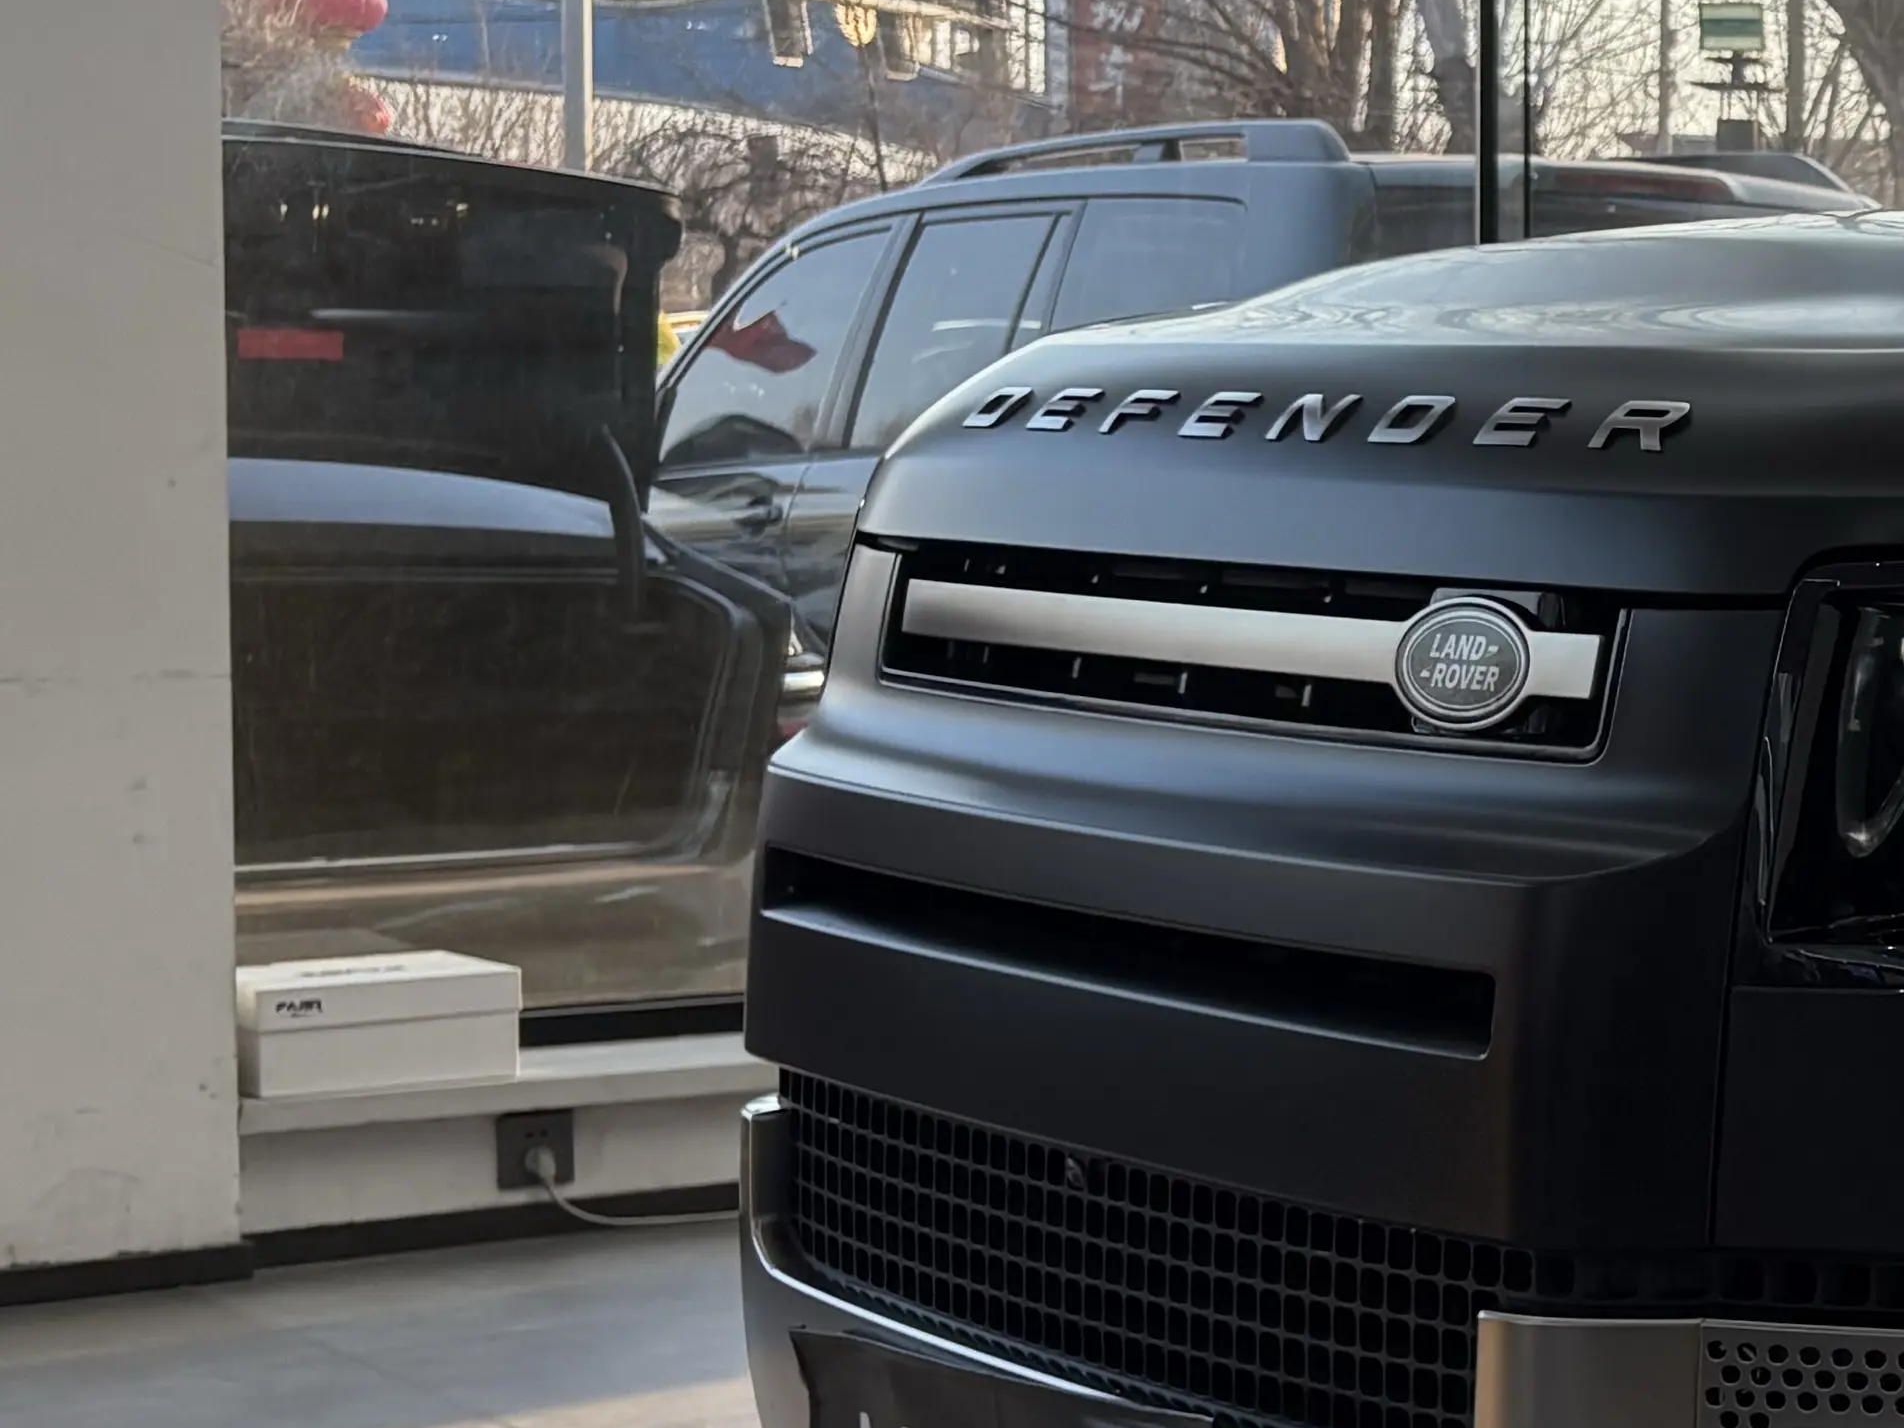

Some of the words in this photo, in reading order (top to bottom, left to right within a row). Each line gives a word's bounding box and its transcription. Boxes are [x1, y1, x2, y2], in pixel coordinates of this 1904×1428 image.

[962, 386, 1692, 451] DEFENDER
[1429, 633, 1487, 661] LAND
[1430, 663, 1500, 692] ROVER
